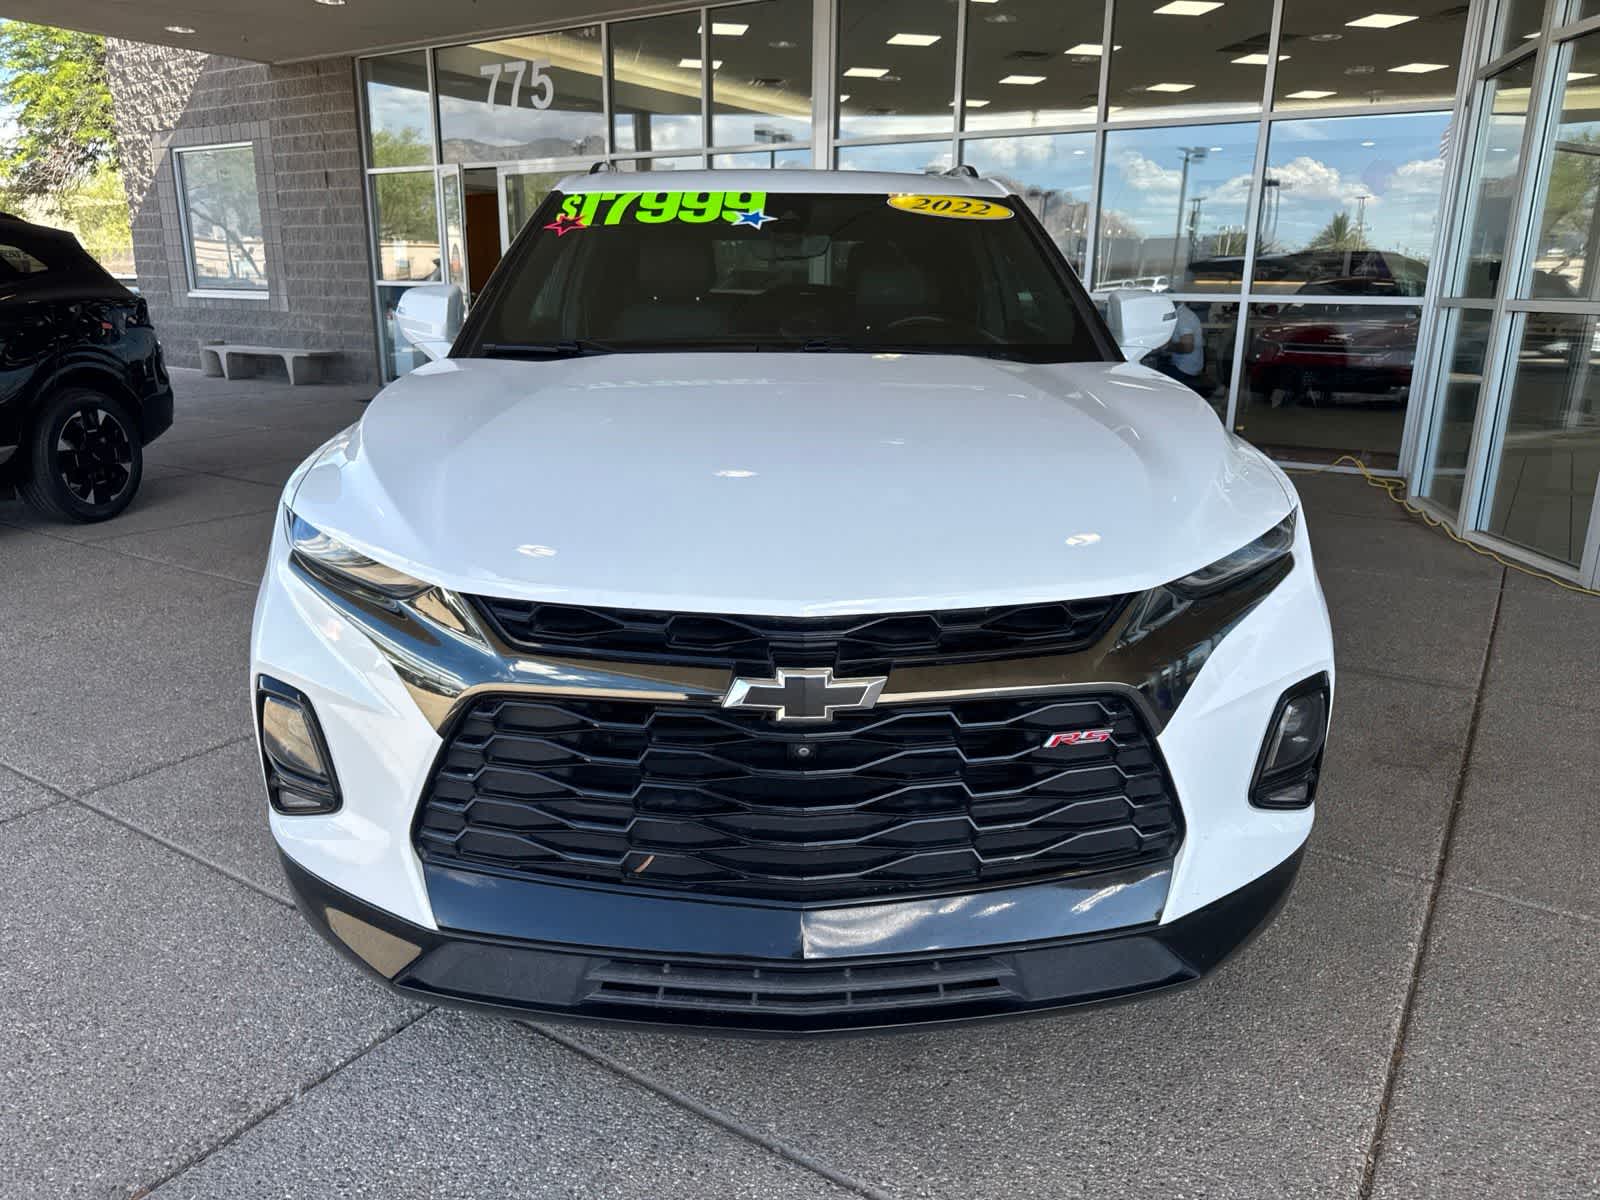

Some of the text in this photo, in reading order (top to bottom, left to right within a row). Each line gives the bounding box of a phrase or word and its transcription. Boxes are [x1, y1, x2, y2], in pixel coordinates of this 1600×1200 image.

[479, 58, 554, 112] 775
[555, 191, 768, 226] $17999
[911, 198, 992, 216] 2022
[1042, 728, 1114, 748] RS
